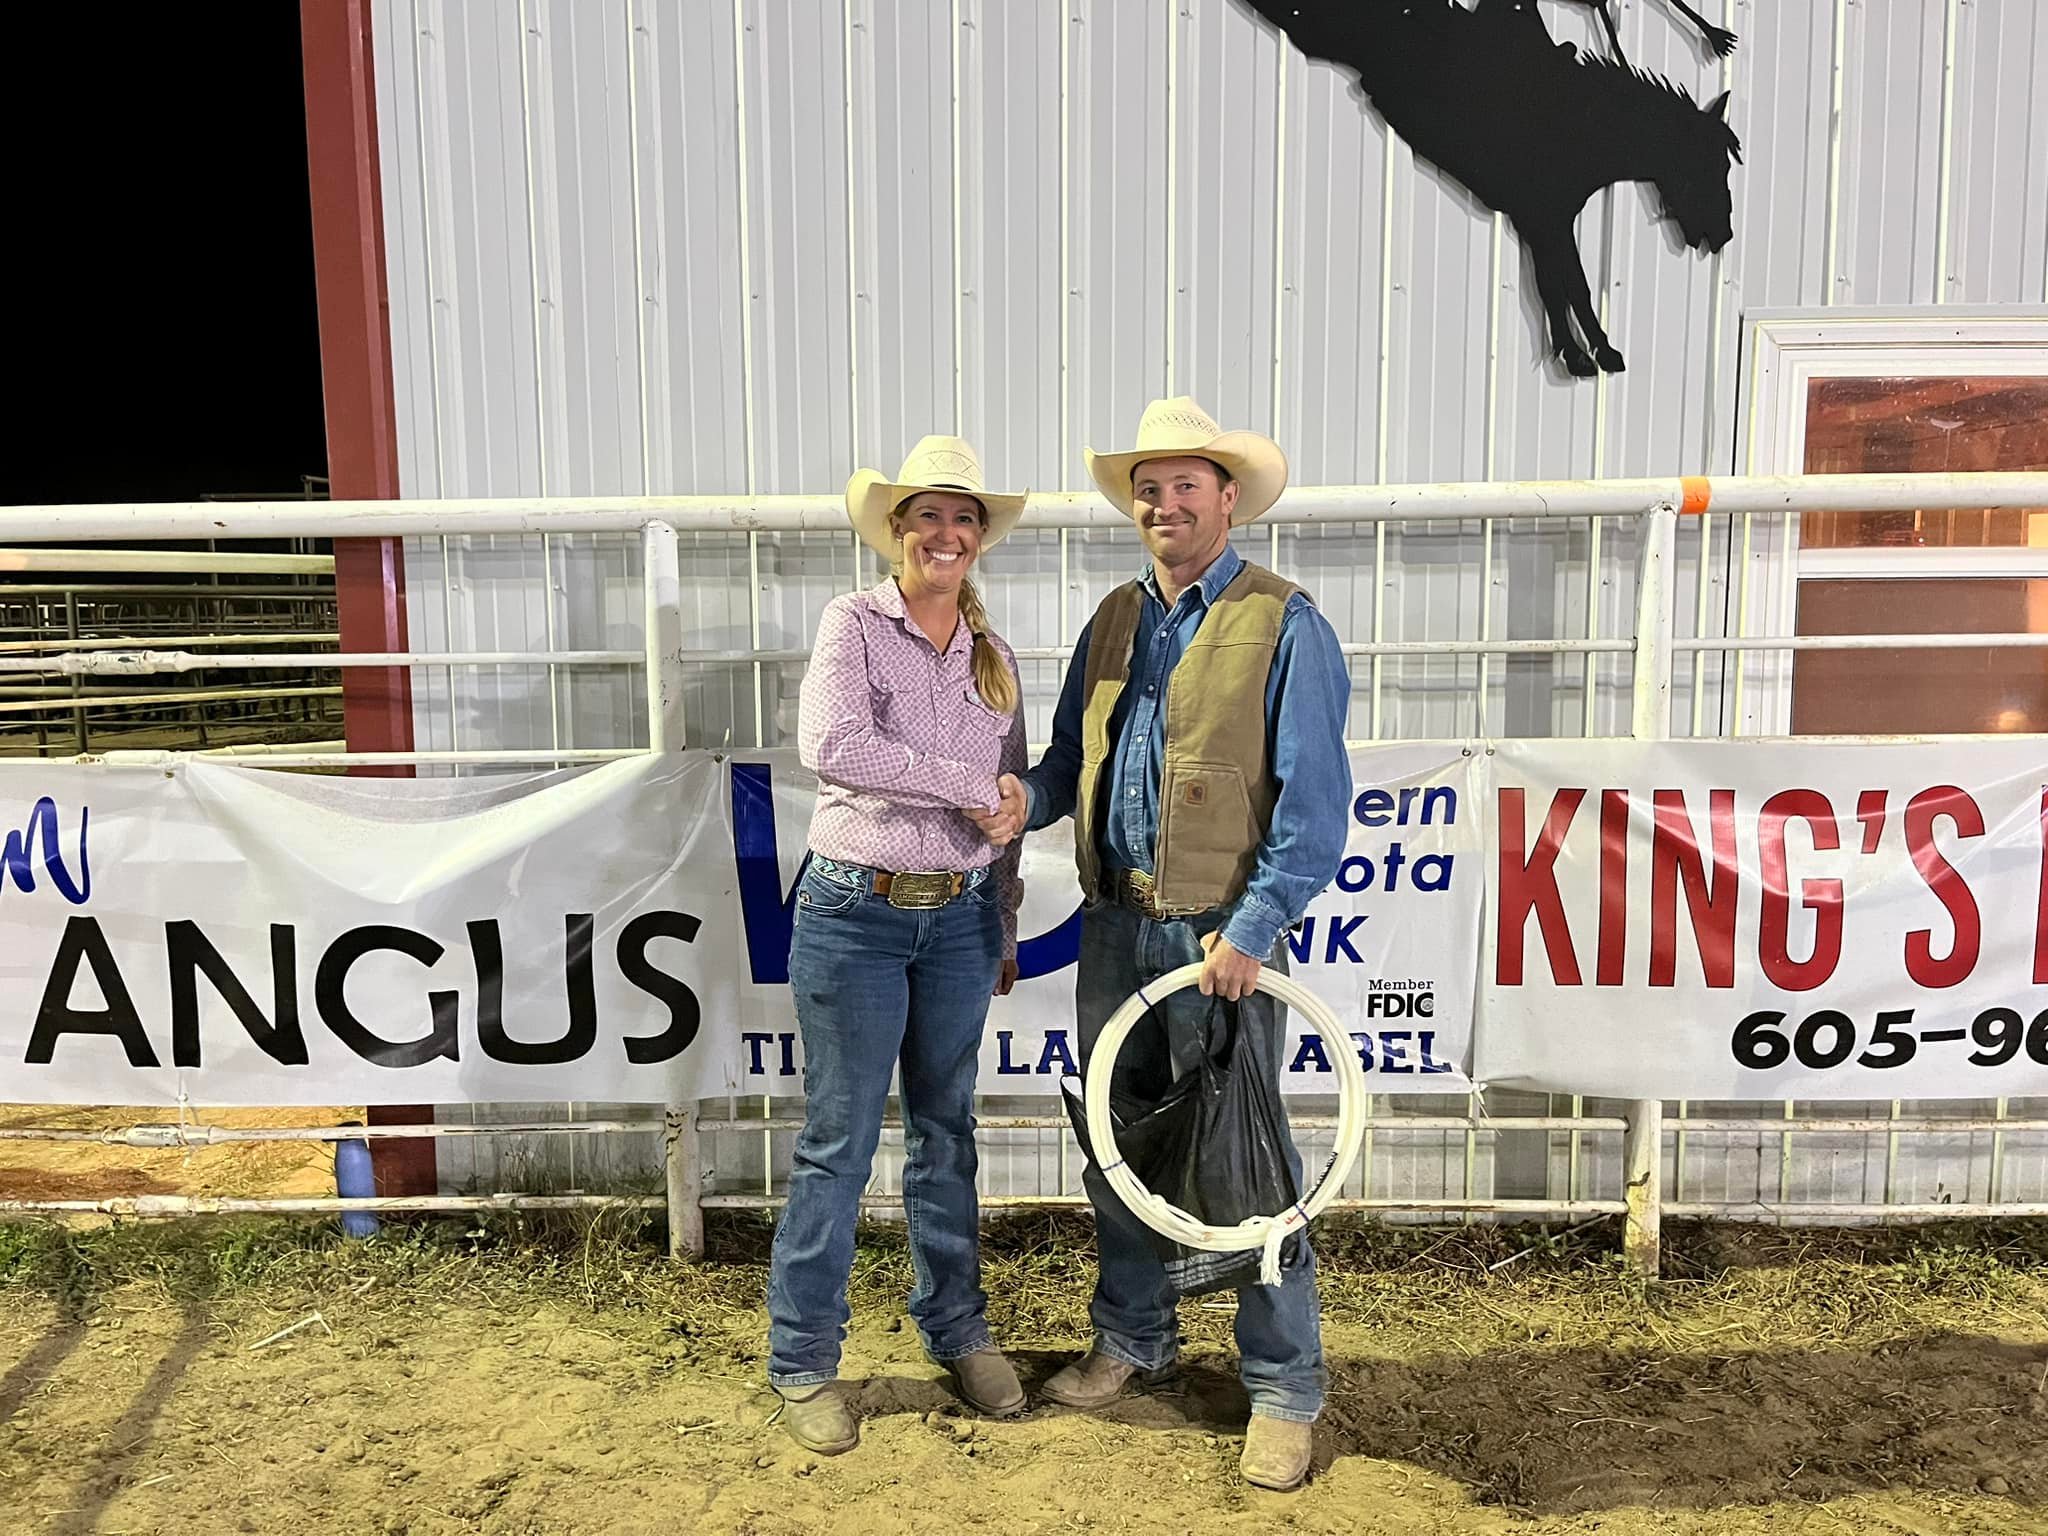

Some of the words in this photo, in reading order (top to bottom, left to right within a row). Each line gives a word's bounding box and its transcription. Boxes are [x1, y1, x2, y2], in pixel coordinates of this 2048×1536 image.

[1353, 786, 1457, 827] ern
[1335, 843, 1454, 893] ota
[1495, 784, 1986, 992] KING'S
[1289, 915, 1370, 964] NK
[23, 909, 703, 1069] ANGUS
[1367, 992, 1434, 1018] FDIC
[1368, 979, 1434, 990] Member
[997, 1030, 1077, 1074] LA
[1289, 1031, 1453, 1074] ABEL
